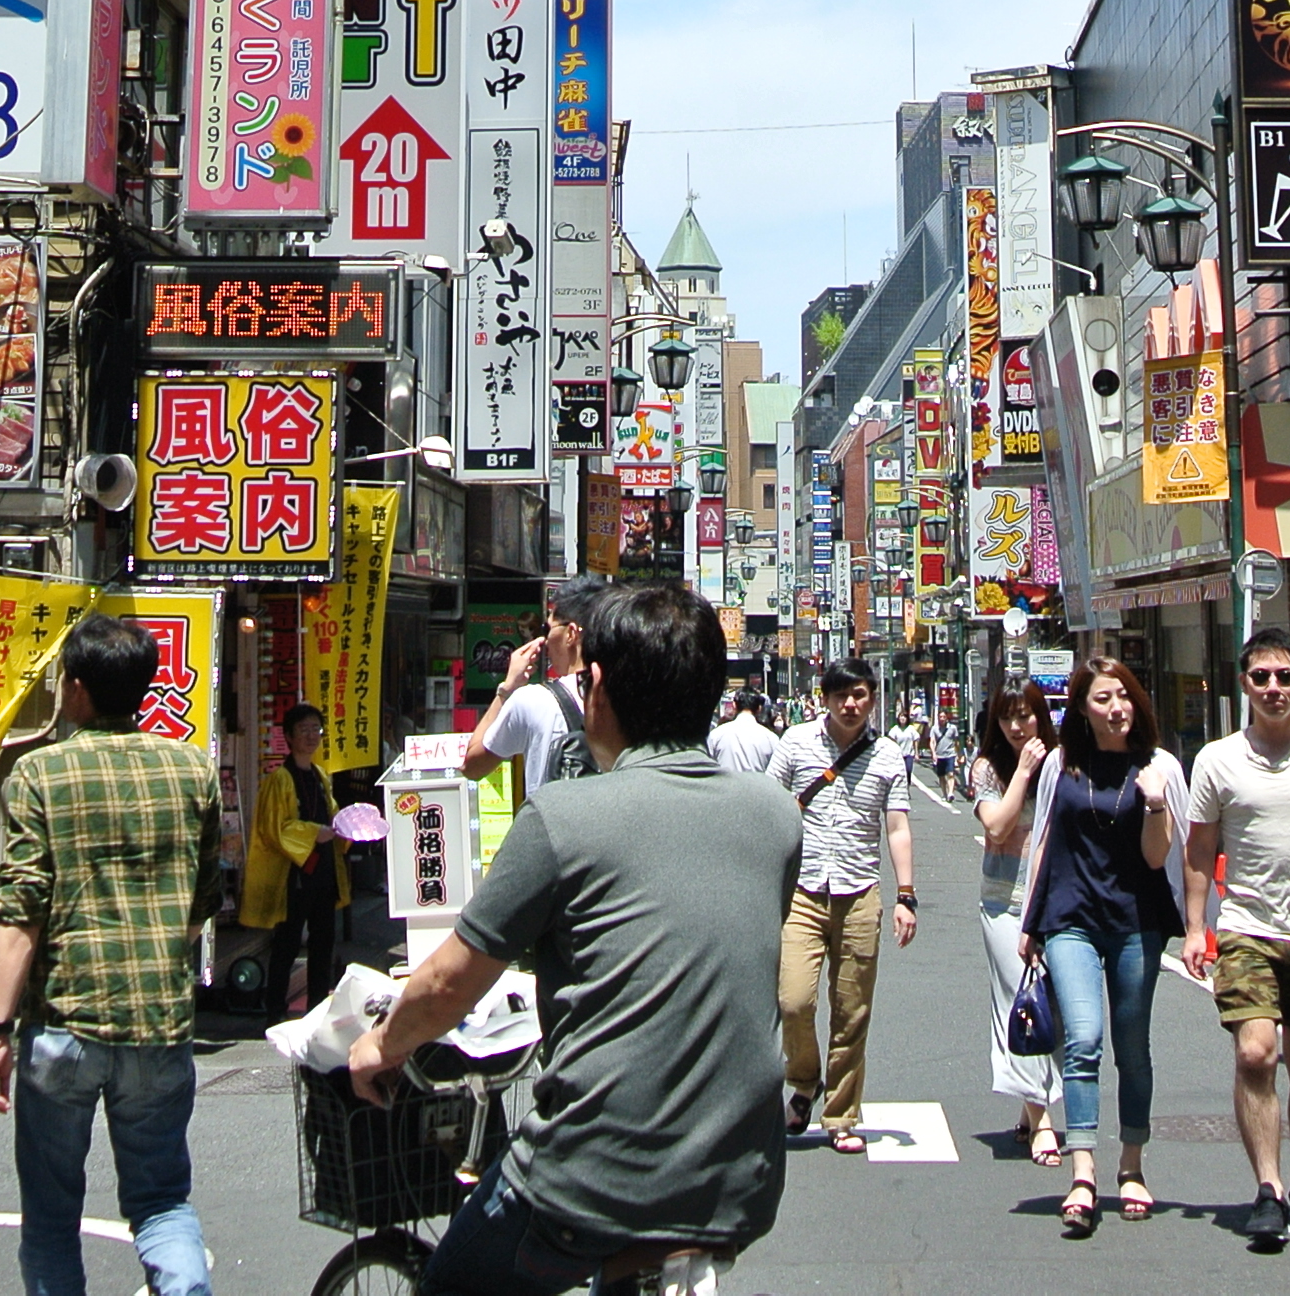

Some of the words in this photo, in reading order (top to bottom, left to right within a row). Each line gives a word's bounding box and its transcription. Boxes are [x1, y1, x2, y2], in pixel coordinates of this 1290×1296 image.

[289, 39, 312, 100] 託児所
[484, 24, 526, 111] 田中
[1259, 131, 1286, 147] B1
[360, 132, 419, 183] 20
[562, 156, 583, 167] 4F
[366, 185, 409, 230] m
[145, 280, 386, 339] 風俗案内
[583, 299, 601, 311] 3F
[584, 365, 603, 377] 2F
[1151, 367, 1216, 394] 悪質な
[581, 412, 597, 425] 2F
[1151, 393, 1216, 420] 客引き
[147, 383, 322, 467] 風俗
[1151, 419, 1219, 446] に注意
[486, 452, 519, 468] B1F
[149, 469, 320, 555] 案内
[703, 507, 720, 540] 八方
[415, 807, 444, 904] 価格勝負
